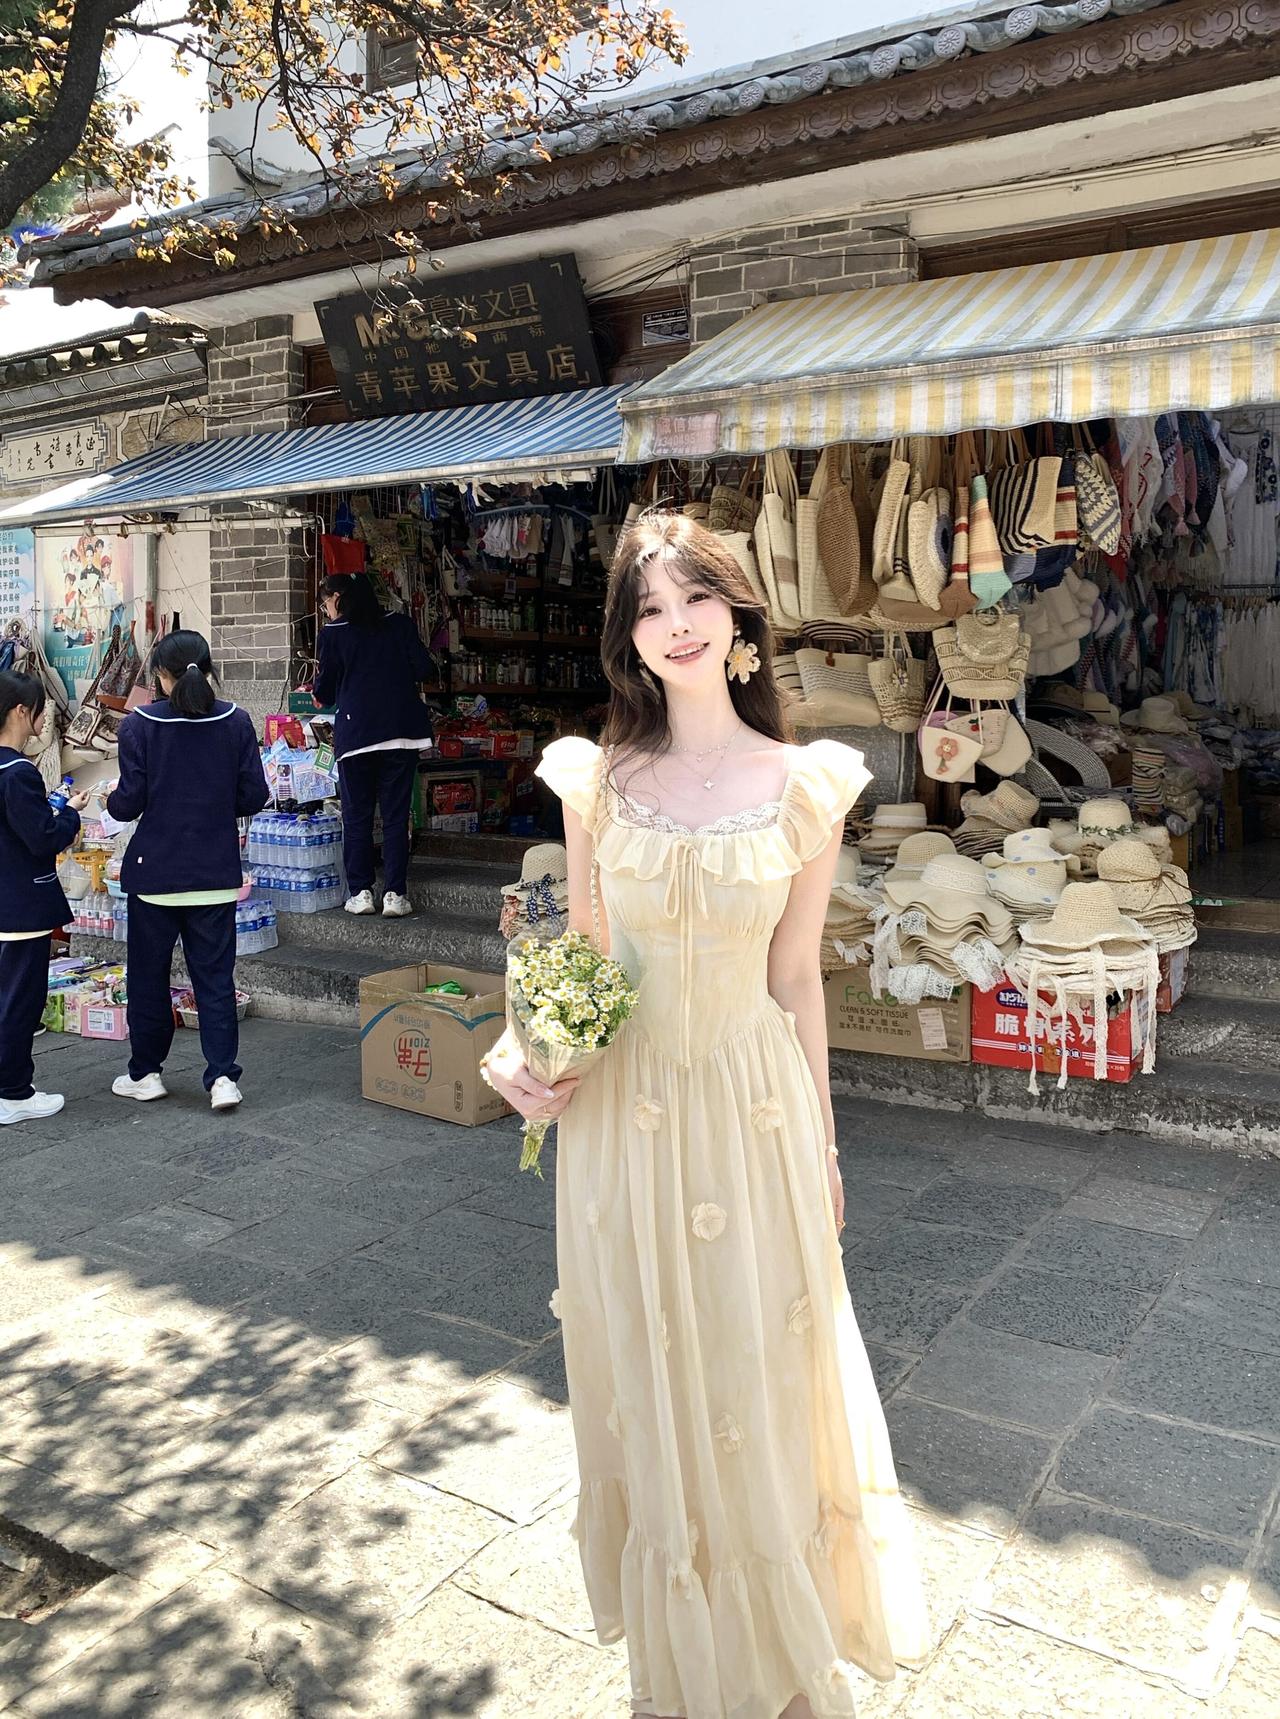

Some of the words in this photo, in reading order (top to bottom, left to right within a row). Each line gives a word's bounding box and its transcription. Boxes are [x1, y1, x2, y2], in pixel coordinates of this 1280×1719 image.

[355, 344, 579, 405] 青苹果文具店
[839, 1005, 859, 1014] CLEAN
[866, 1008, 883, 1016] SOFT
[885, 1010, 909, 1019] TISSUE
